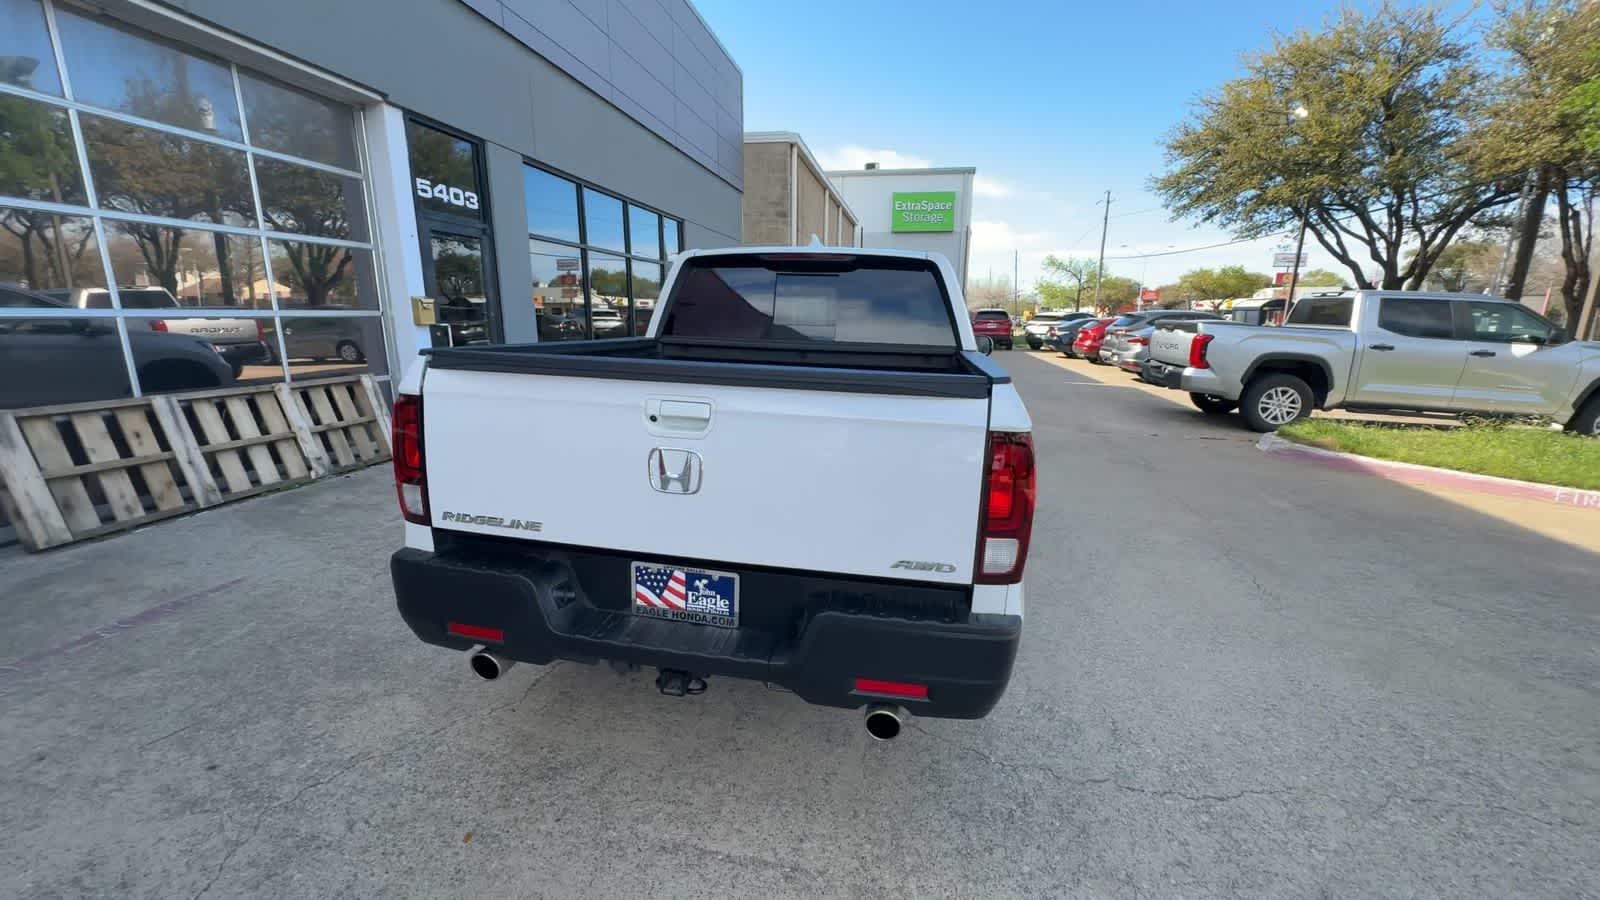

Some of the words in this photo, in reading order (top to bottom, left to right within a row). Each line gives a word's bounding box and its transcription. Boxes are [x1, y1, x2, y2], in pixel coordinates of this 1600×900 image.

[415, 177, 479, 209] 5403
[895, 200, 952, 212] ExtraSpace
[903, 211, 944, 223] Storage
[442, 511, 543, 531] RIDGELINE
[890, 560, 957, 573] AWD
[699, 588, 716, 597] John
[687, 591, 730, 611] Eagle
[636, 606, 669, 618] EAGLE
[671, 609, 736, 627] HONDA.COM
